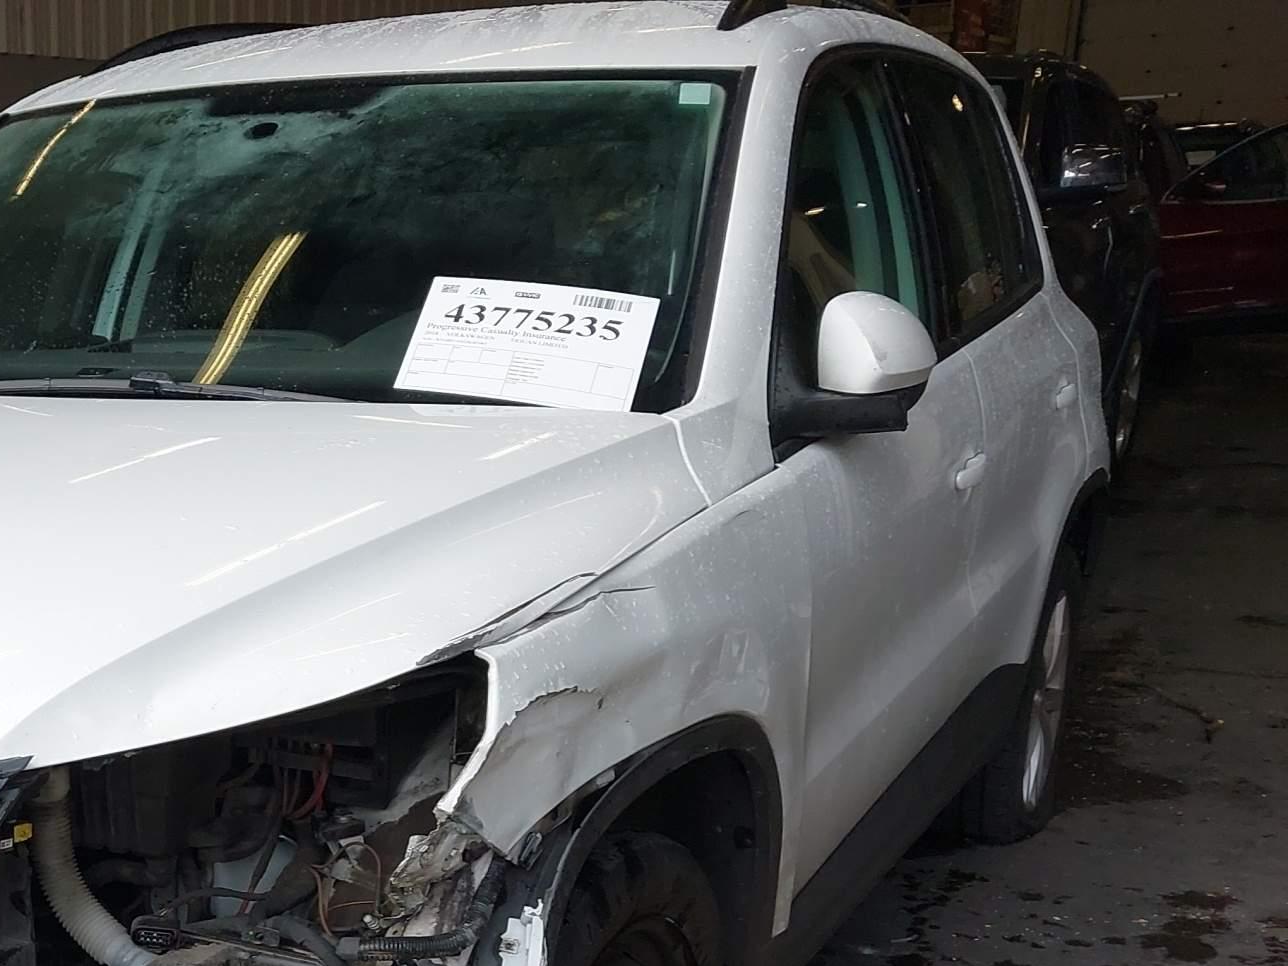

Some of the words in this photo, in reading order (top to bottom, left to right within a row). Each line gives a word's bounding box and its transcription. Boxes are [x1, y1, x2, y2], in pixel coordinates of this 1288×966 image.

[426, 322, 479, 333] Progressive
[480, 326, 521, 338] Casualty
[522, 329, 568, 342] Insurance
[444, 303, 625, 342] 43775235
